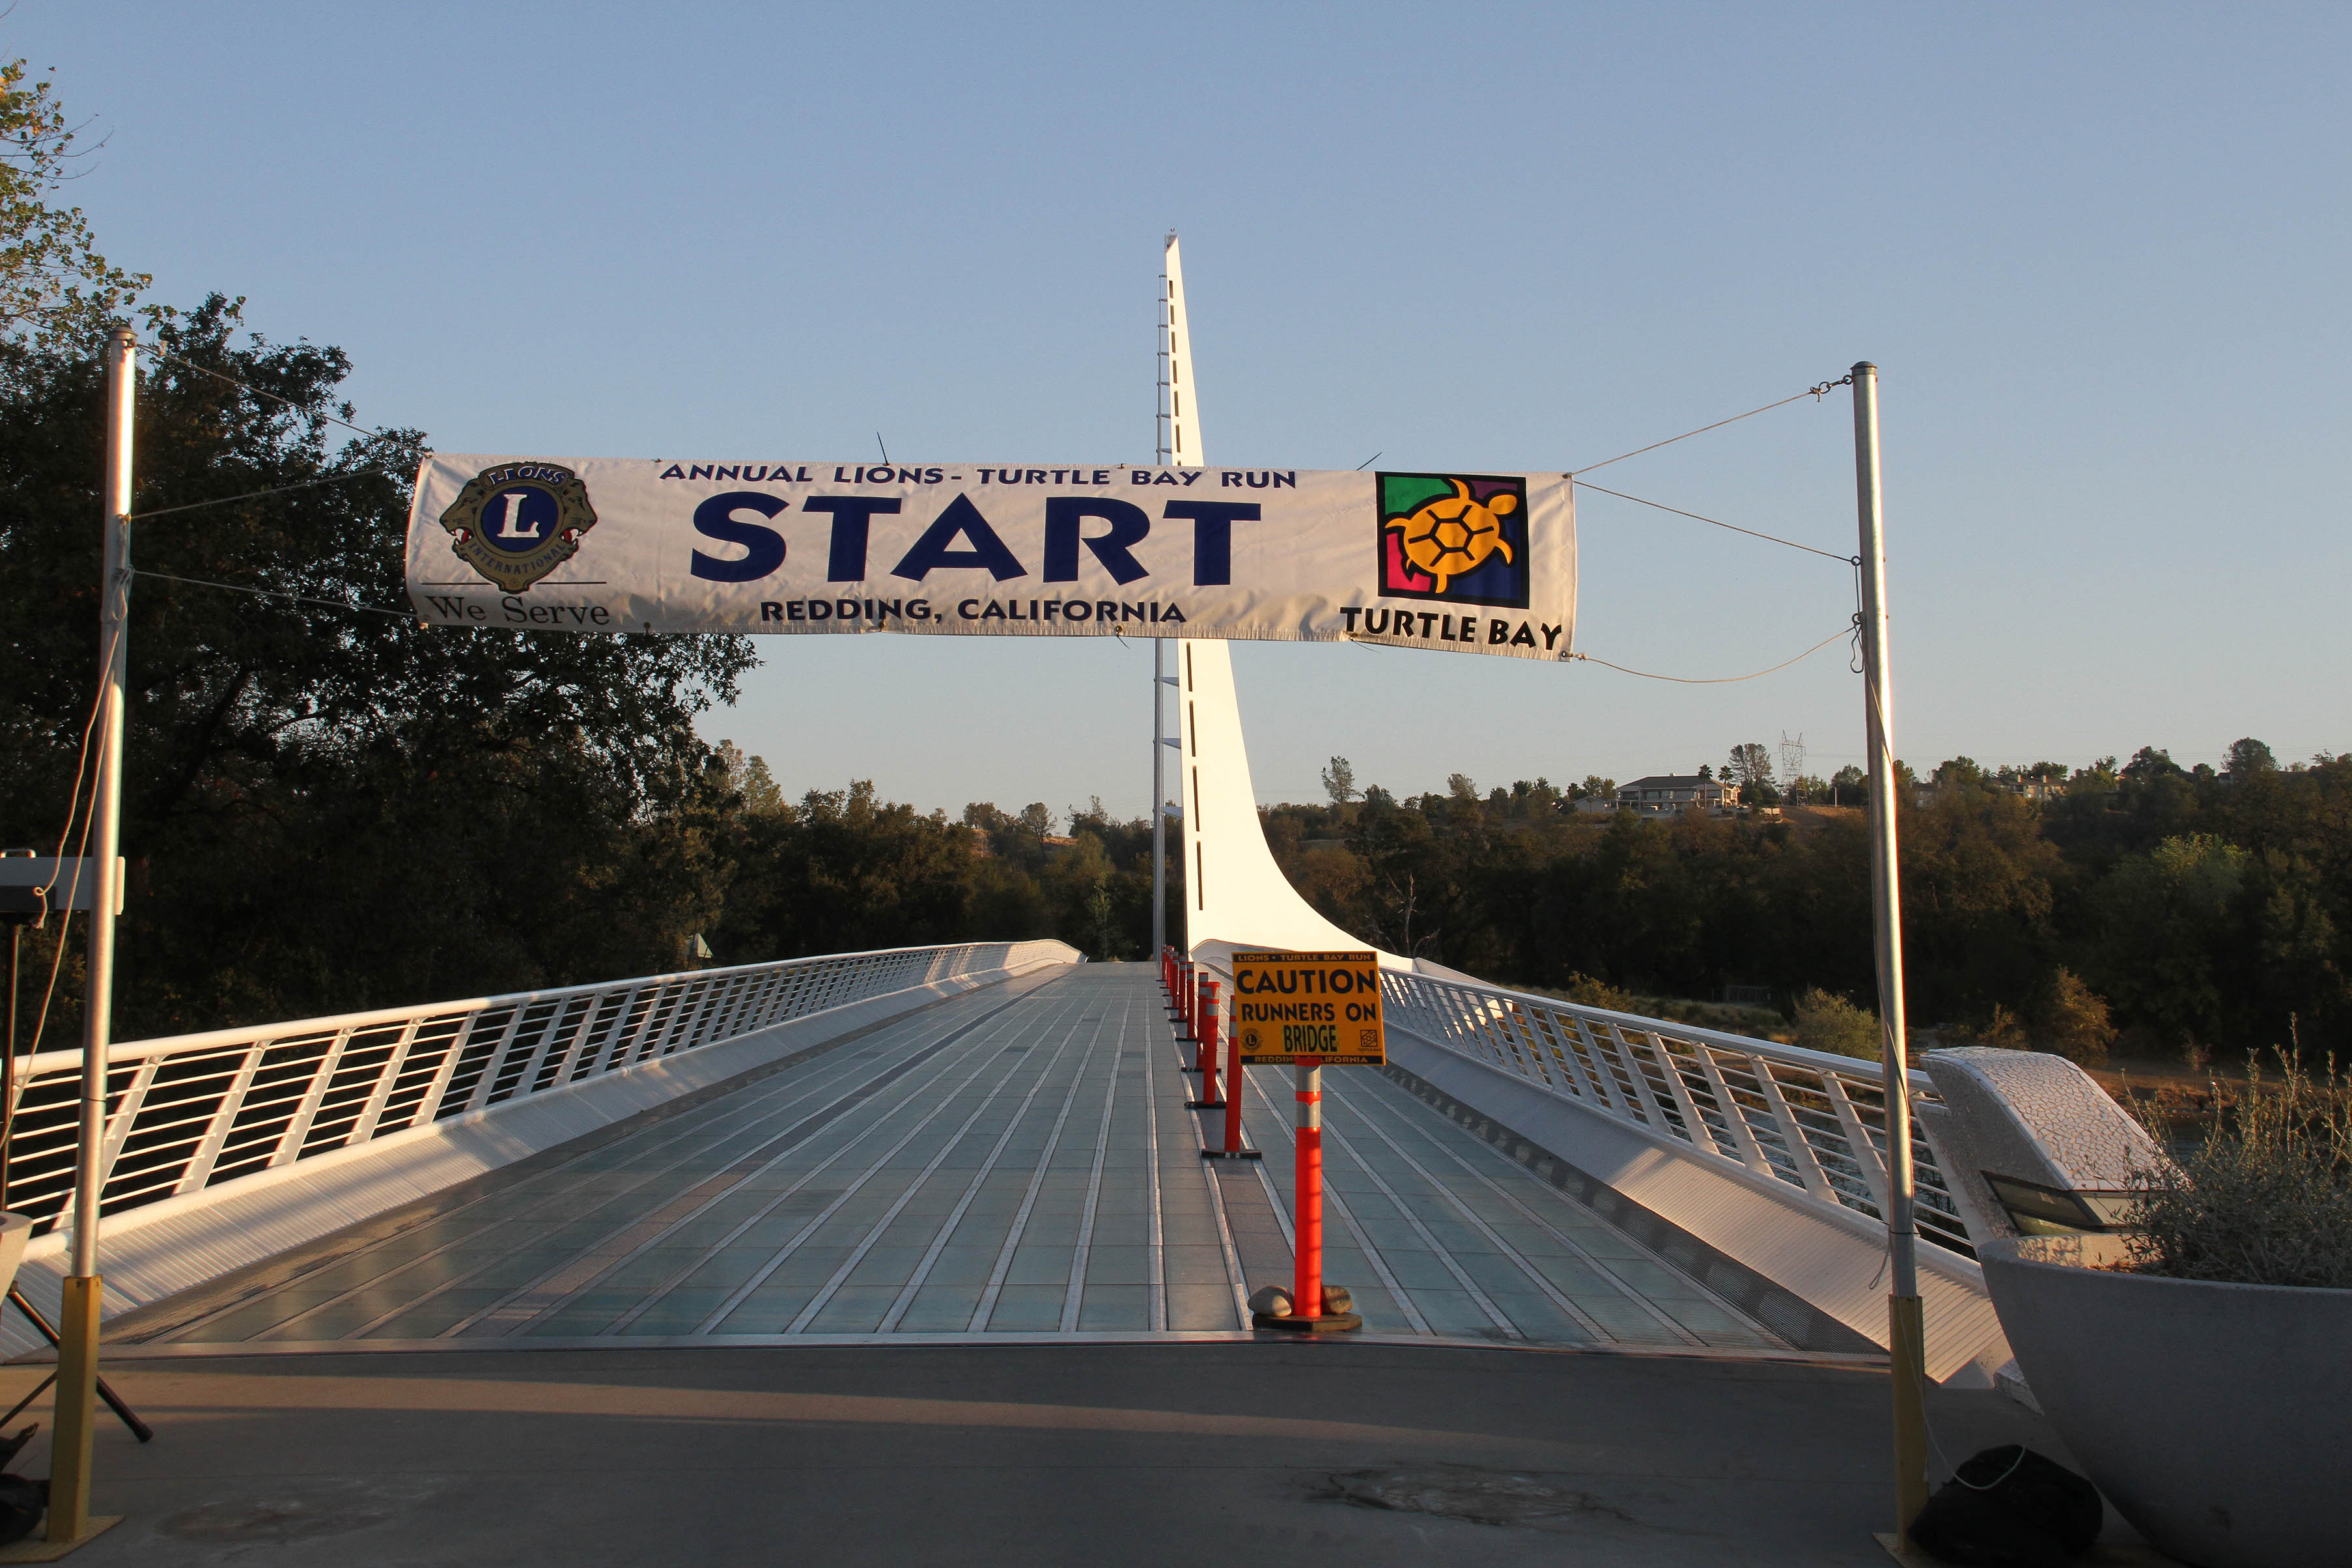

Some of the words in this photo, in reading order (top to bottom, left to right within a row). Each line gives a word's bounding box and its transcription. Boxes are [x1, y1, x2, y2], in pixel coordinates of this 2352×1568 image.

[488, 465, 567, 485] LIONS
[659, 464, 814, 483] ANNUAL
[980, 469, 1110, 486] TURTLE
[1131, 470, 1203, 486] BAY
[1221, 471, 1296, 489] RUN
[497, 494, 540, 538] L
[690, 492, 1261, 586] START
[468, 541, 567, 575] INTERNATIONAL
[425, 596, 486, 621] We
[501, 595, 610, 625] Serve
[760, 598, 942, 624] REDDING,
[957, 598, 1187, 624] CALIFORNIA
[1339, 606, 1477, 643] TURTLE
[1488, 619, 1563, 651] BAY
[1236, 969, 1377, 995] CAUTION
[1241, 1002, 1335, 1022] RUNNERS
[1345, 1002, 1377, 1022] ON
[1283, 1025, 1337, 1053] BRIDGE
